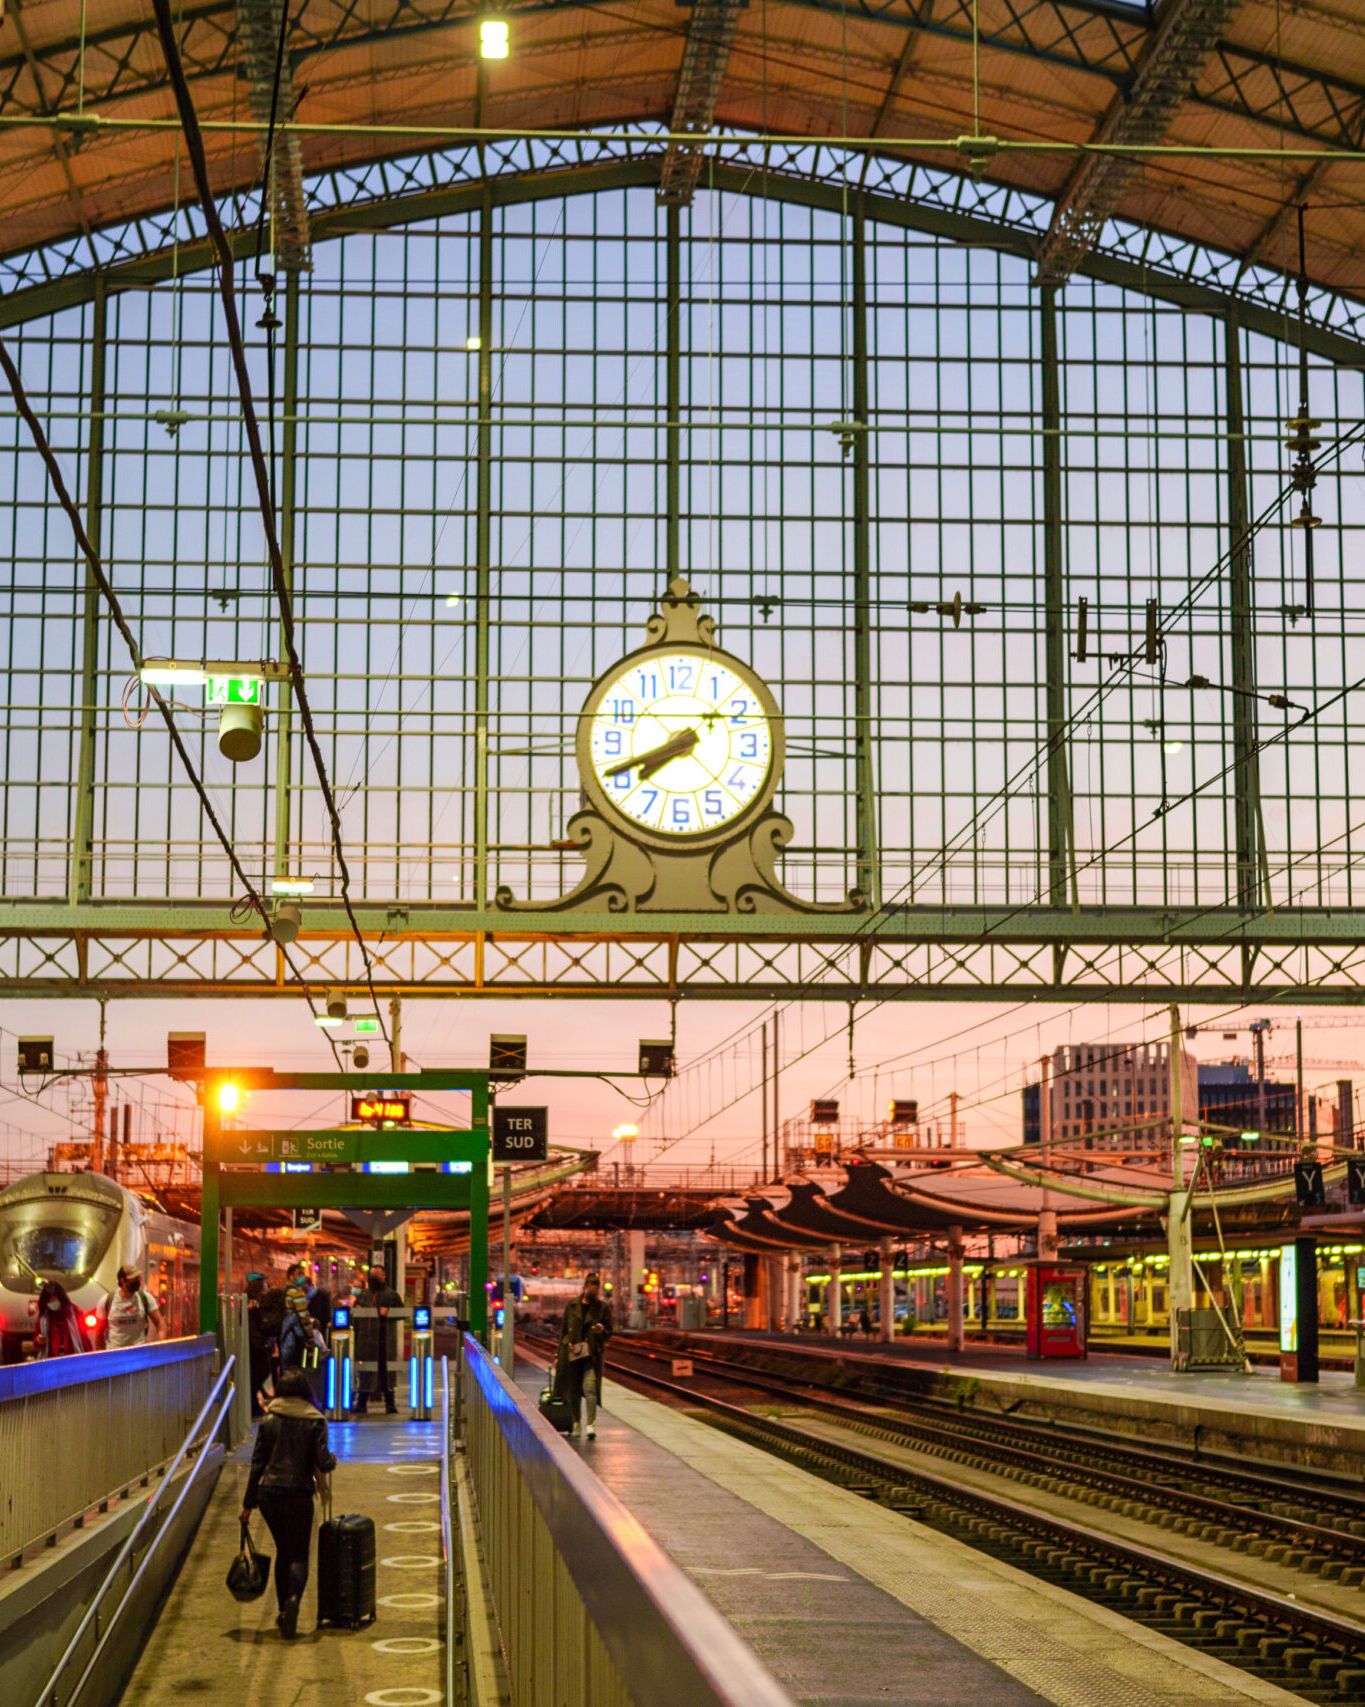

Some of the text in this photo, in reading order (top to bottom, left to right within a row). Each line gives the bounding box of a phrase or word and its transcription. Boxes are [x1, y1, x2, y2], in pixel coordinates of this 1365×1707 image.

[640, 674, 657, 698] 11
[669, 665, 693, 690] 12
[711, 676, 718, 700] 1
[613, 699, 634, 724] 10
[730, 700, 748, 724] 2
[604, 730, 622, 755] 9
[740, 733, 757, 758] 3
[727, 766, 747, 790] 4
[641, 790, 658, 814] 7
[672, 799, 690, 823] 6
[705, 790, 722, 815] 5
[506, 1118, 533, 1130] TER
[307, 1137, 345, 1150] Sortie
[505, 1136, 534, 1149] SUD
[1302, 1170, 1316, 1191] Y
